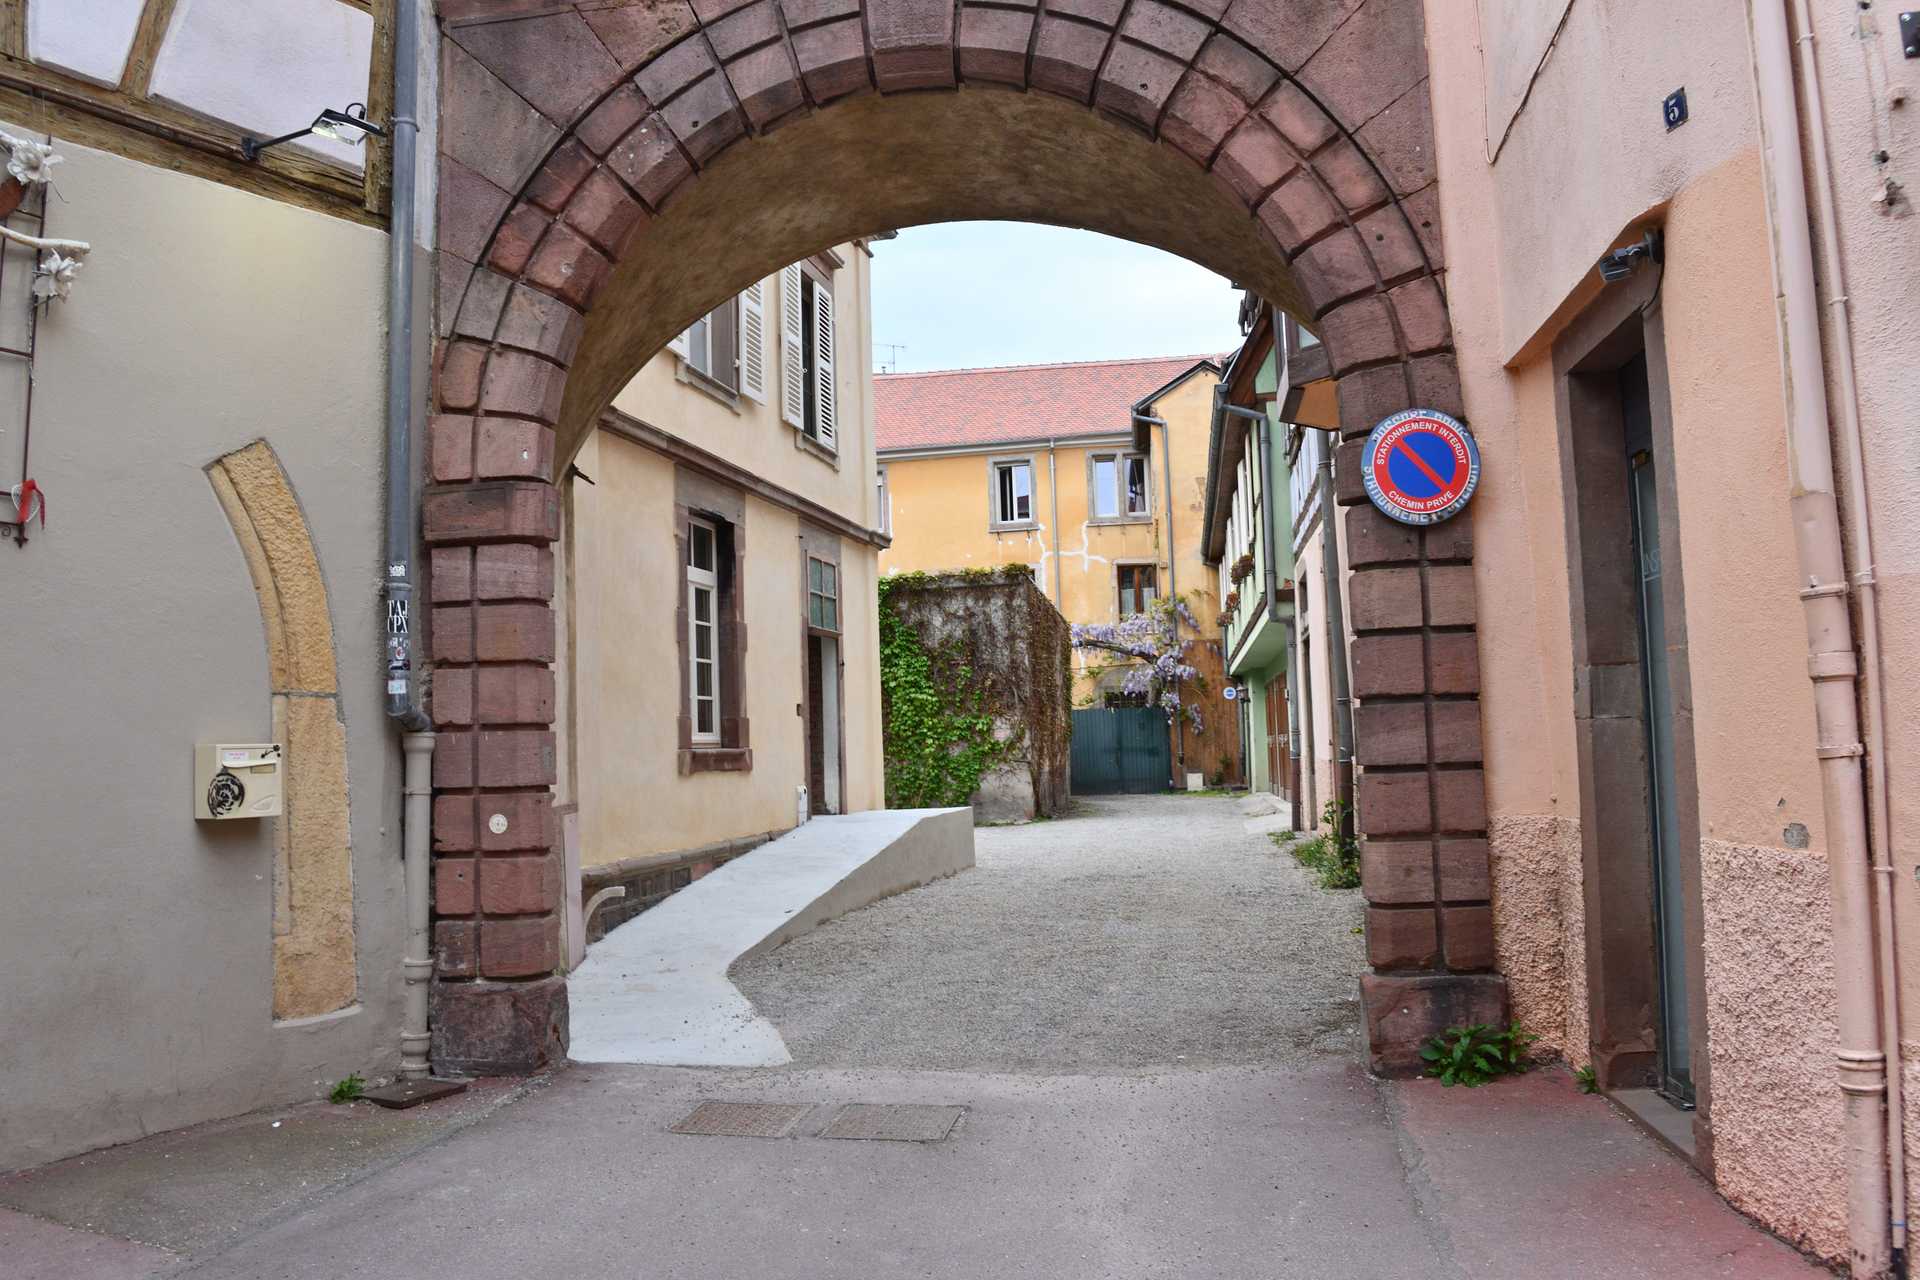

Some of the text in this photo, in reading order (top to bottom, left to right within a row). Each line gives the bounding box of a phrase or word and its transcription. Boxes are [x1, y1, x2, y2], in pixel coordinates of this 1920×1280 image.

[1668, 98, 1680, 122] 5
[1376, 421, 1467, 465] STATIONNEMENT INTERDIT
[1388, 490, 1454, 510] CHEMIN PRIVE
